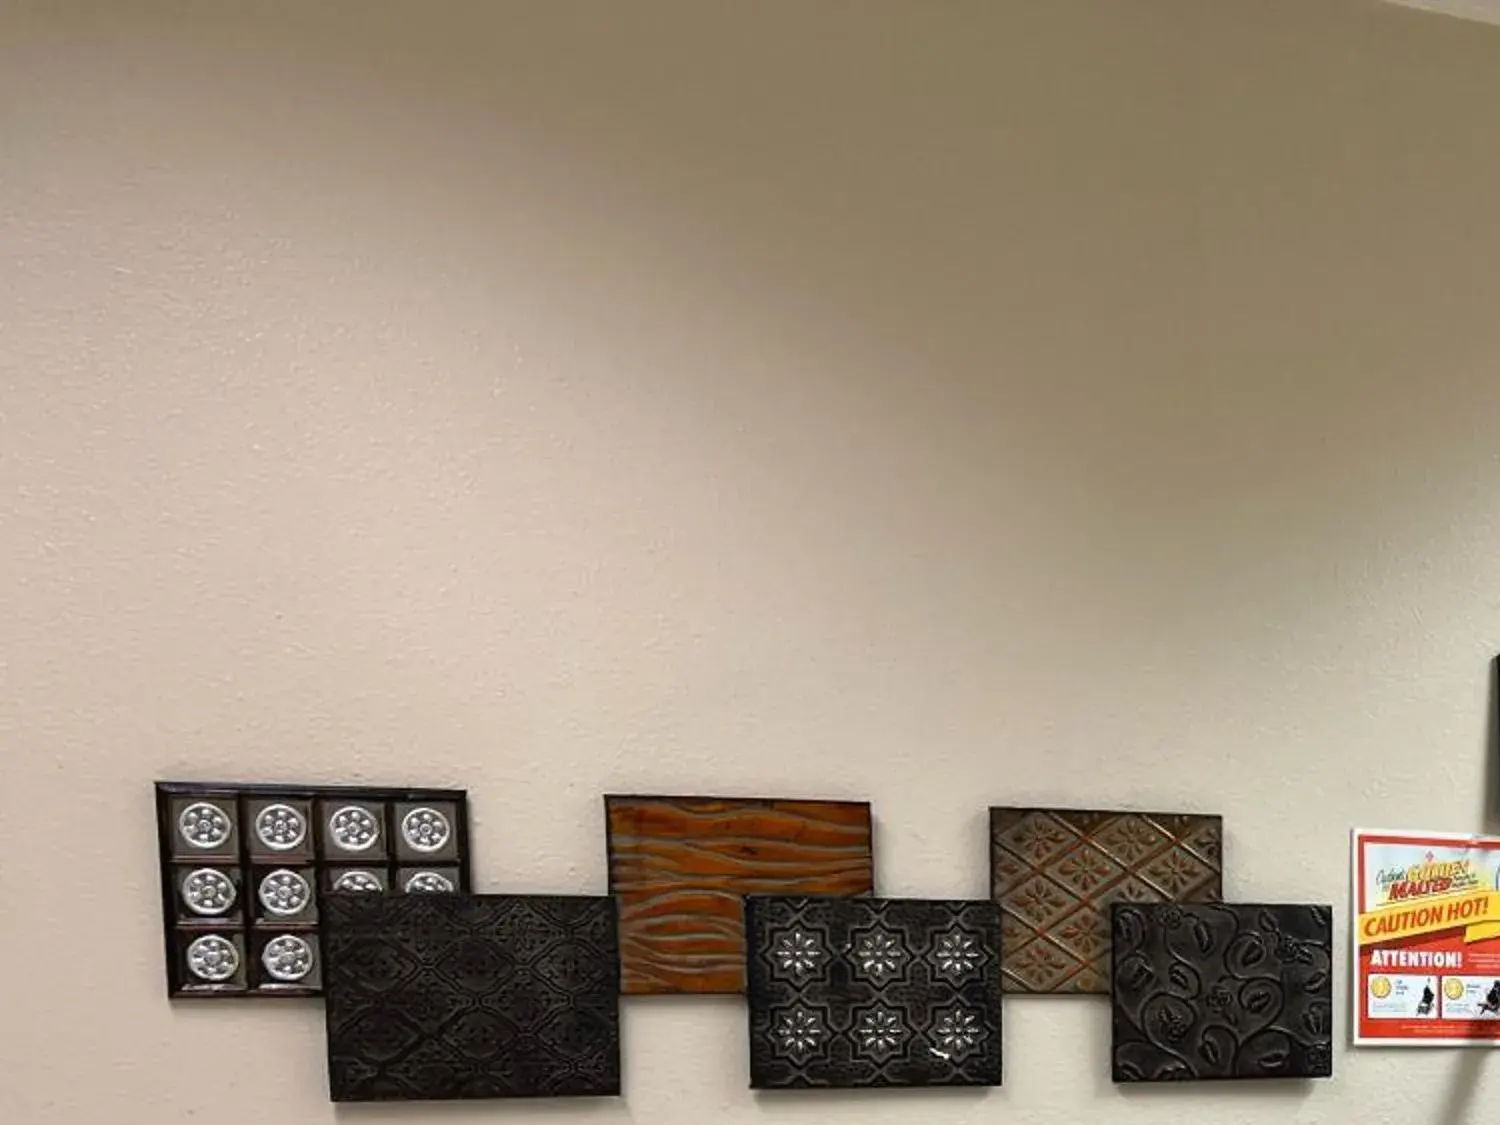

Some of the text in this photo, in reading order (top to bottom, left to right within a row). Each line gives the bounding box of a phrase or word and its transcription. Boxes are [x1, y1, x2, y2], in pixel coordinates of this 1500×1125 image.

[1364, 897, 1489, 937] CAUTION HOT!
[1370, 949, 1463, 968] ATTENTION!
